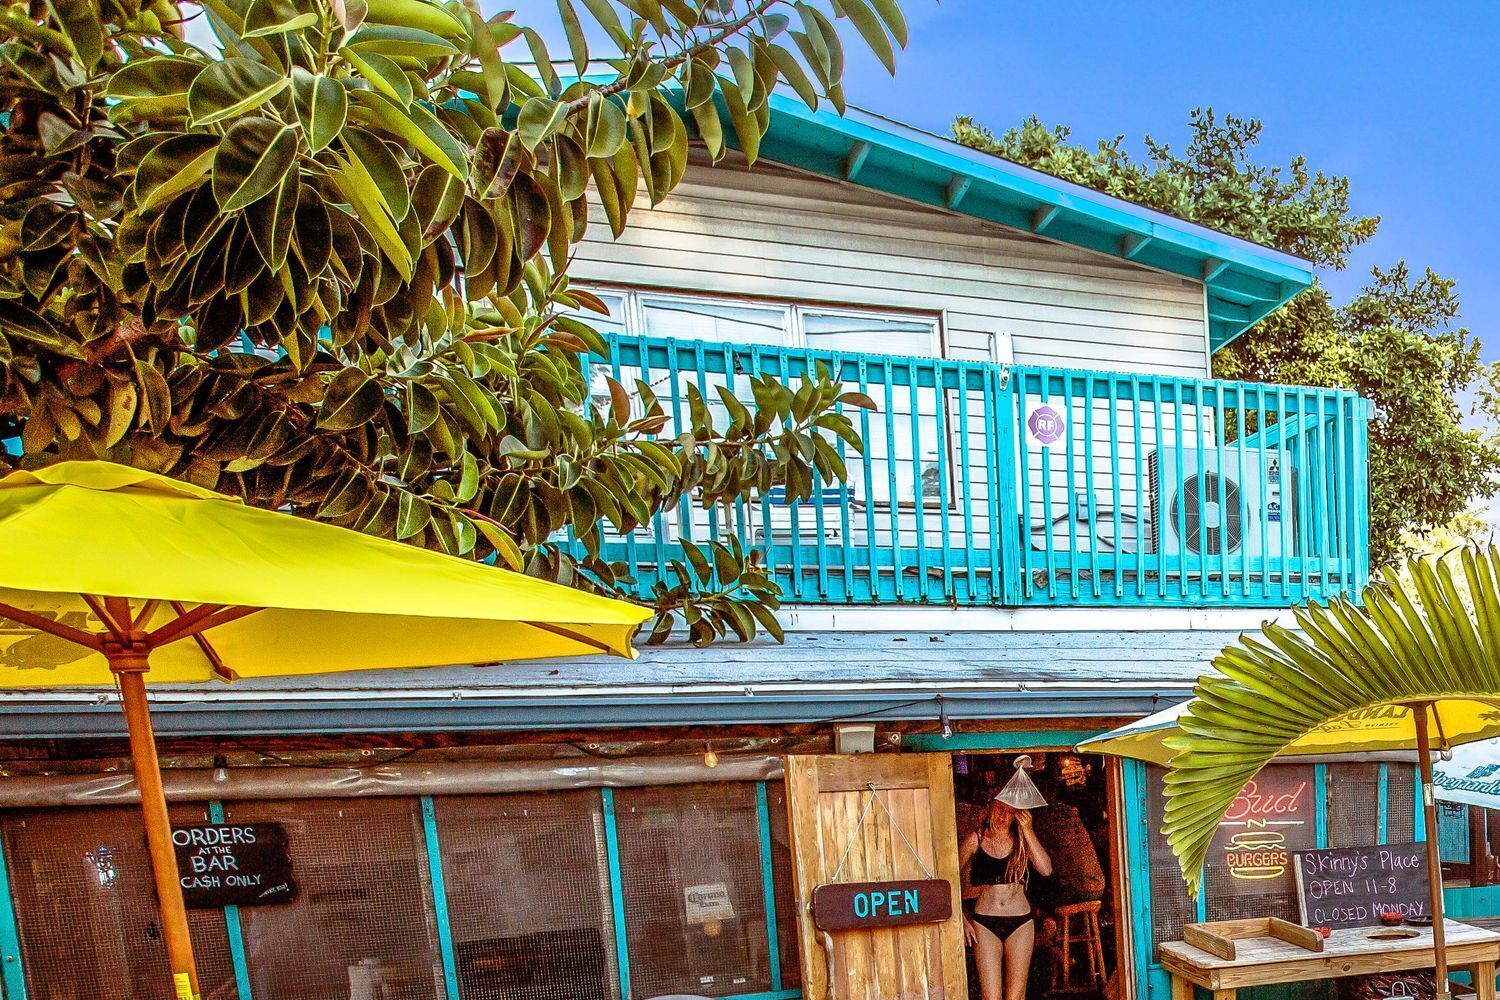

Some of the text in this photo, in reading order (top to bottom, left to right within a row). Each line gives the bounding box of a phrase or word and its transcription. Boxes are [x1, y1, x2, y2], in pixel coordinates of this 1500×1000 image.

[1038, 418, 1055, 431] RF
[1223, 780, 1307, 819] Bud
[172, 827, 257, 846] ORDERS
[198, 846, 232, 855] AT THE
[1226, 851, 1289, 867] BURGERS
[191, 855, 239, 873] BAR
[1305, 850, 1420, 878] Skinny's Place
[226, 874, 262, 887] ONLY
[1309, 876, 1397, 899] OPEN 11-8
[853, 889, 919, 918] OPEN
[1314, 900, 1424, 924] CLOSED MONDAY
